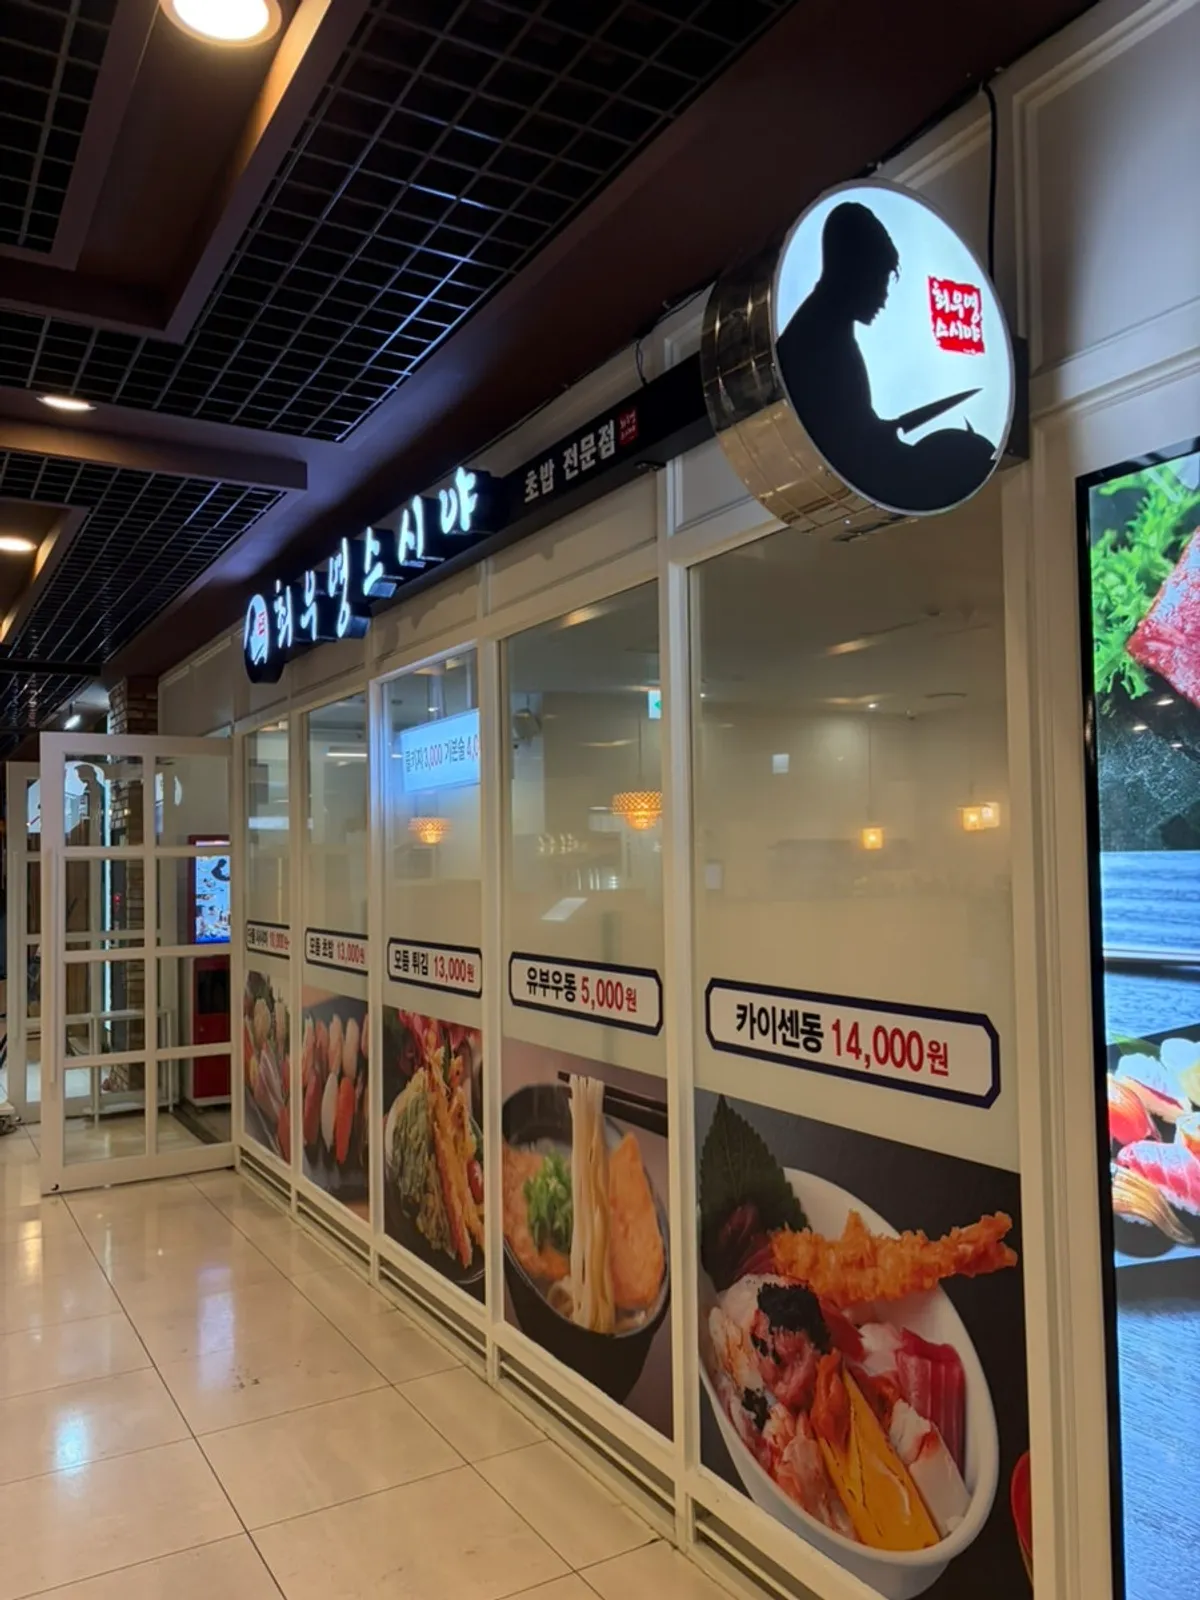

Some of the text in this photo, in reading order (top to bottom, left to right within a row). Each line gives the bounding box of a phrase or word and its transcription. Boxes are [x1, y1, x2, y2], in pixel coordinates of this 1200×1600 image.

[524, 458, 555, 503] 초밥
[562, 419, 616, 481] 전문점
[394, 949, 475, 984] 모듬 튀김 13,000원
[526, 966, 638, 1013] 유부우동 5,000원
[735, 1002, 949, 1077] 카이센동 14,000원
